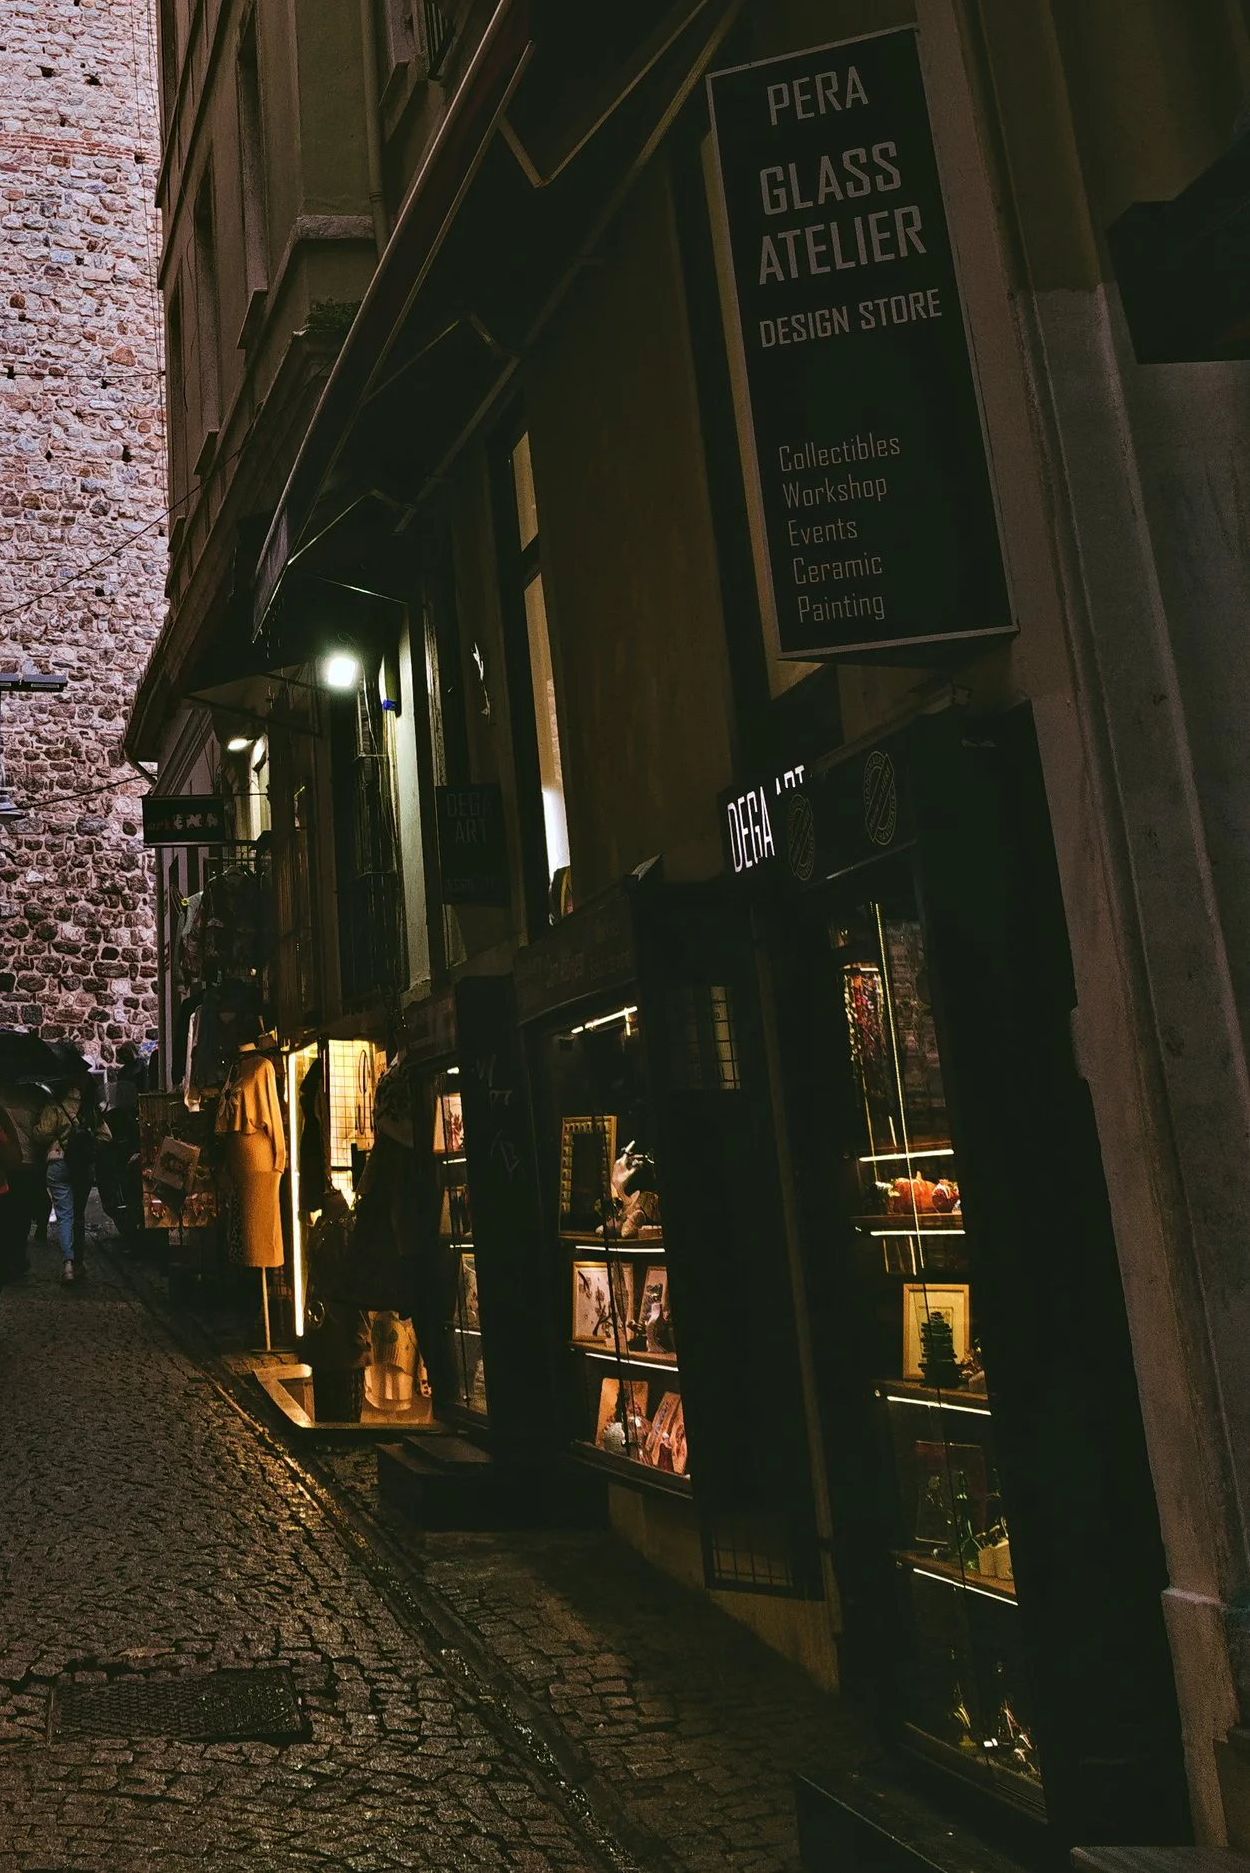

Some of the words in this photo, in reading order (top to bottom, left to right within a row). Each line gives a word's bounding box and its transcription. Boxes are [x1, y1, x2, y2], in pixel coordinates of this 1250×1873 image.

[766, 65, 869, 126] PERA
[759, 140, 902, 216] GLASS
[758, 204, 928, 286] ATELIER
[759, 305, 850, 349] DESIGN
[857, 287, 943, 330] STORE
[778, 432, 901, 473] Collectibles
[782, 473, 888, 510] Workshop
[787, 518, 859, 547] Events
[792, 551, 883, 585] Ceramic
[797, 592, 886, 624] Painting
[455, 818, 487, 845] ART
[727, 785, 776, 874] DEGA
